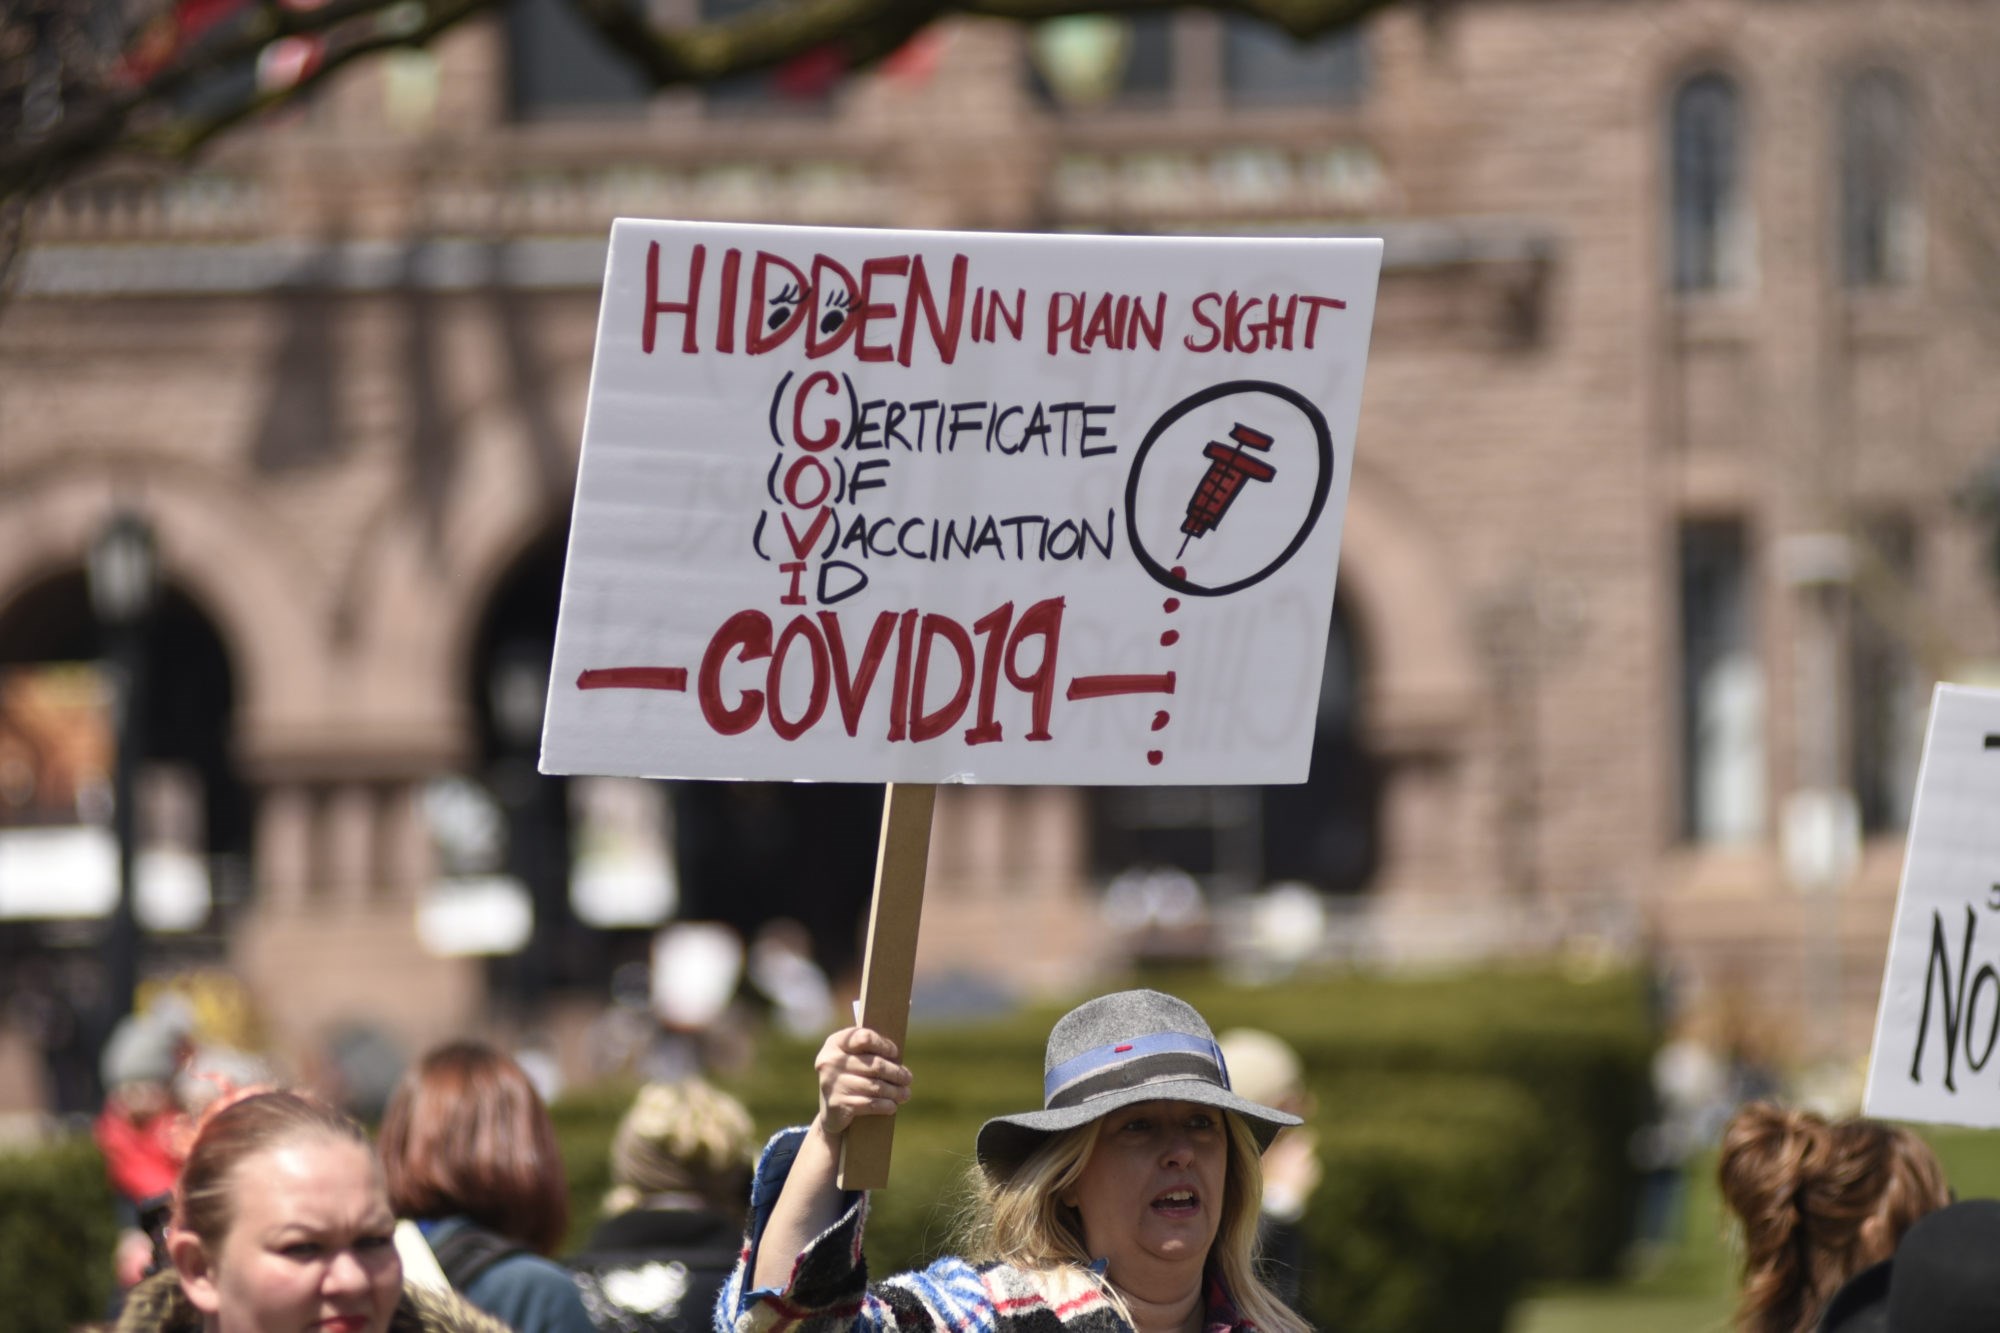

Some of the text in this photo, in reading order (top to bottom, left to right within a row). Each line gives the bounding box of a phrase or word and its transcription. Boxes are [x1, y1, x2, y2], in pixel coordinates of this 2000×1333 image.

[641, 239, 1347, 369] HIDDEN IN PLAIN SIGHT
[769, 369, 1118, 459] (C)ERTIFICATE
[766, 451, 891, 510] (O)F
[752, 504, 1116, 563] (V)ACCINATION
